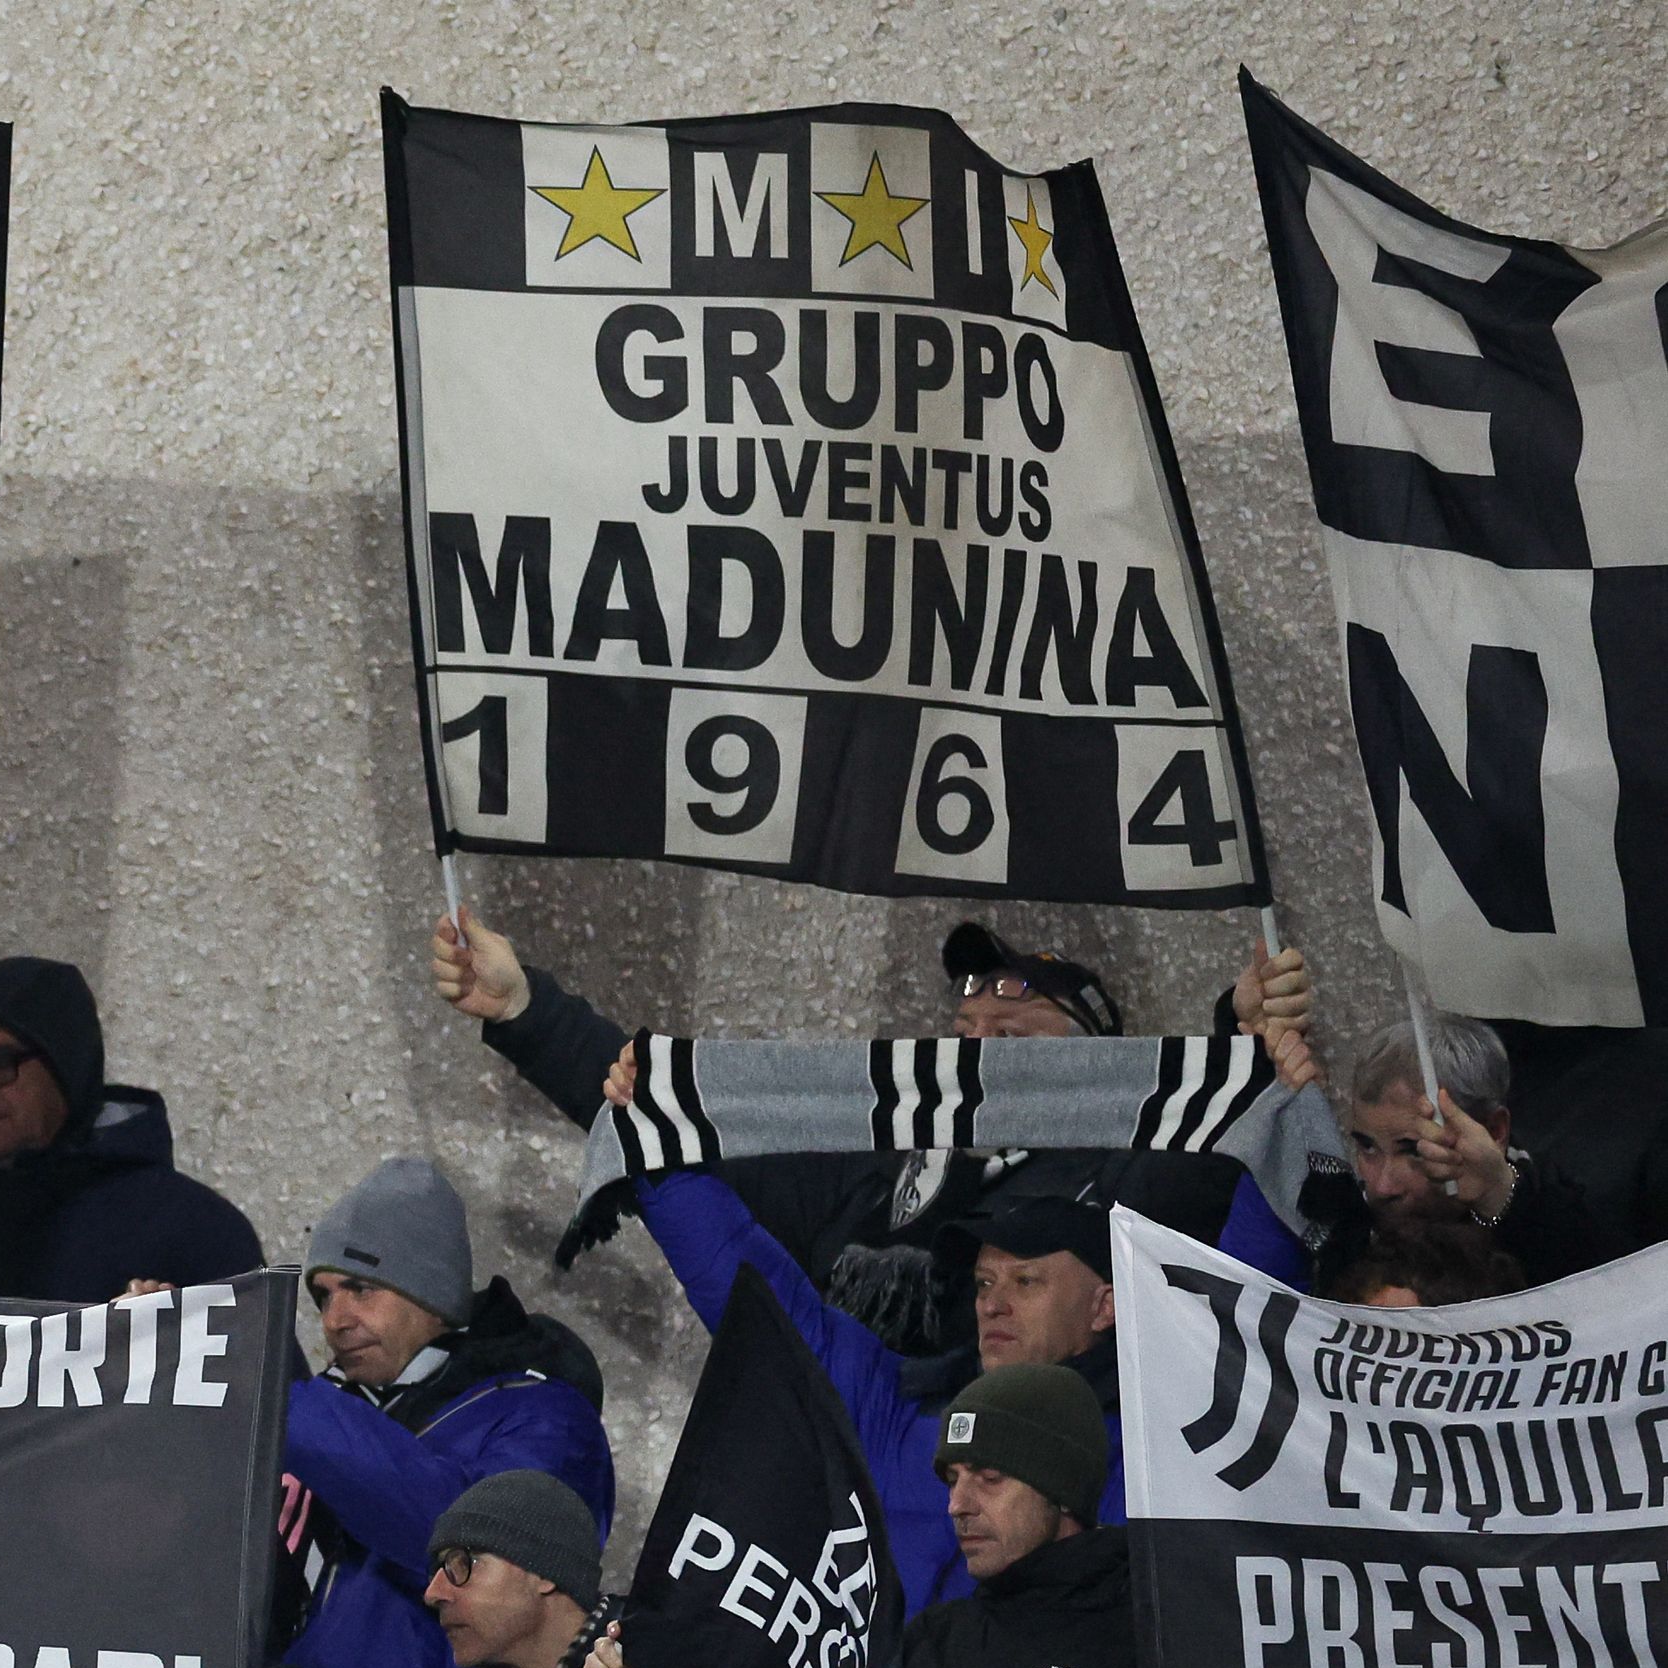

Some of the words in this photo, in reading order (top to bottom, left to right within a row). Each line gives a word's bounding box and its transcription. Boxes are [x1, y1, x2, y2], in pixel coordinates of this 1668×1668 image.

[594, 304, 1065, 452] GRUPPO
[641, 436, 1052, 542] JUVENTUS
[427, 511, 1207, 710] MADUNINA
[1313, 1347, 1519, 1412] OFFICIAL
[1533, 1350, 1629, 1407] FAN
[1320, 1318, 1572, 1366] JUVENTUS
